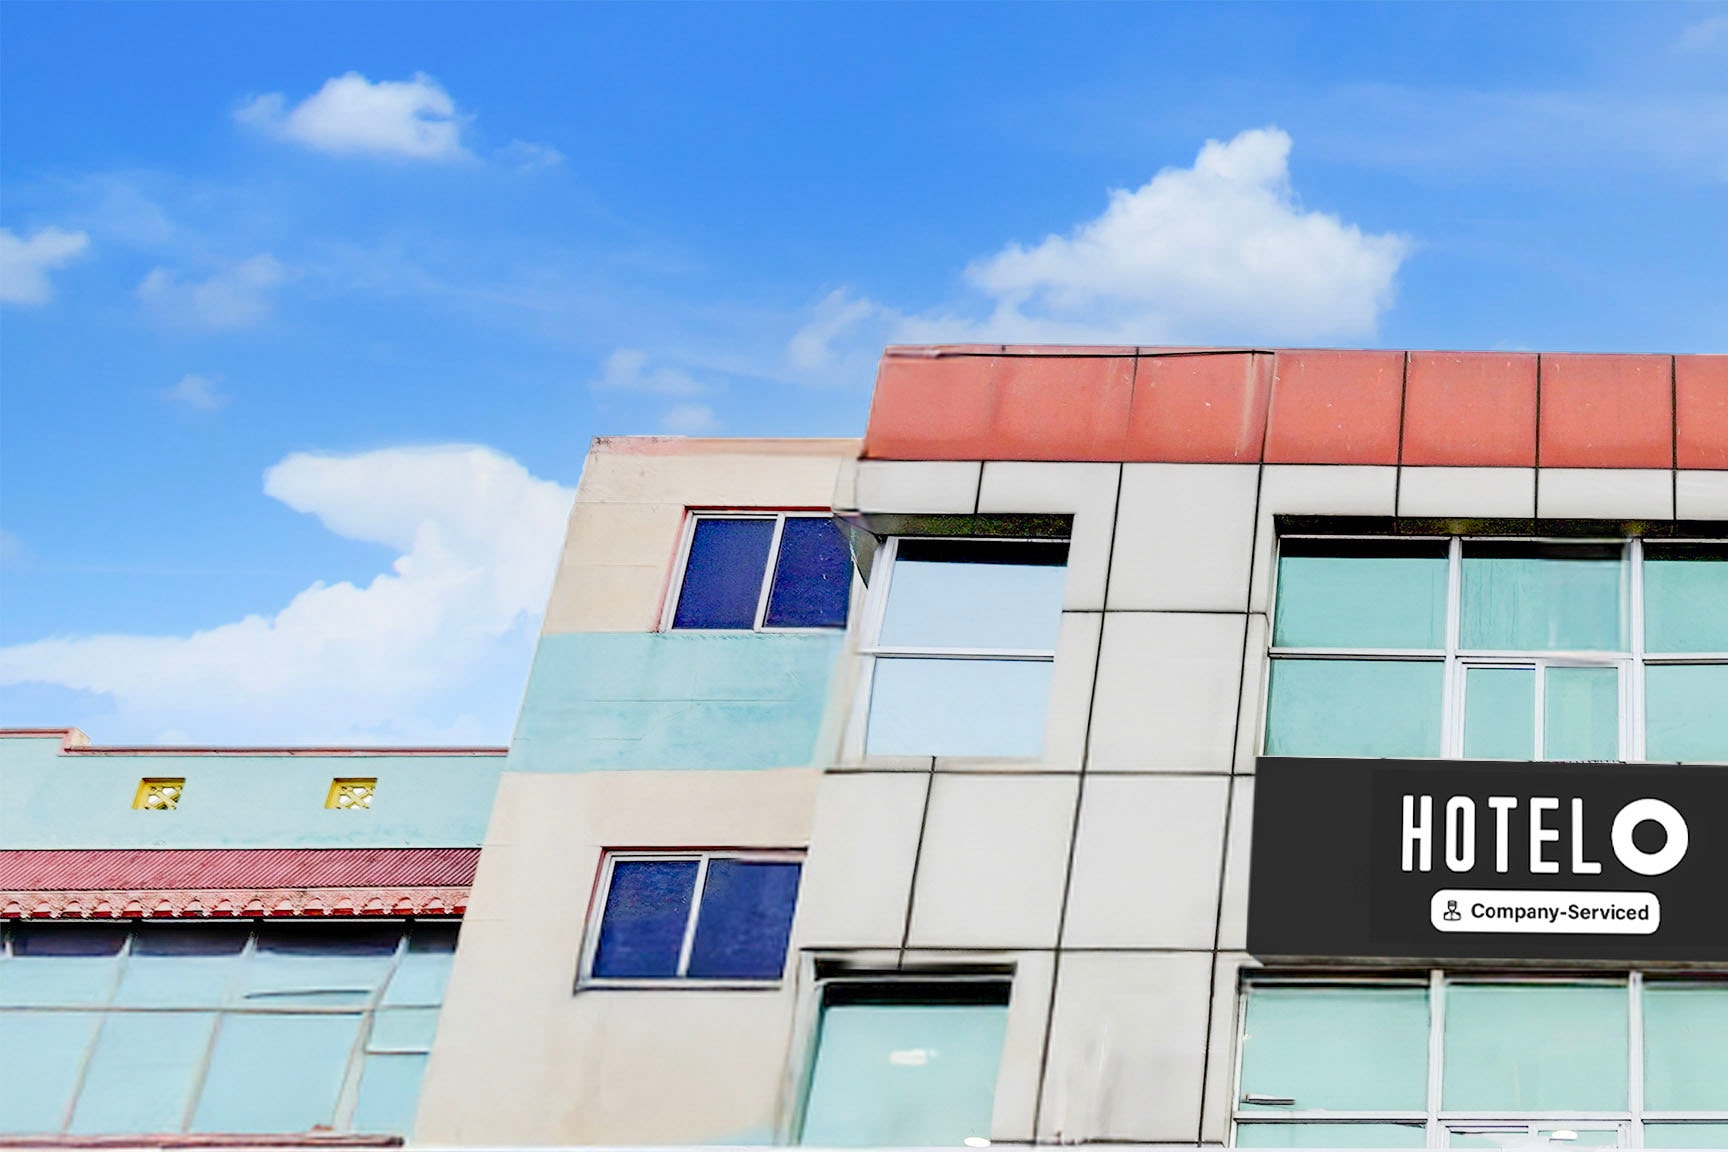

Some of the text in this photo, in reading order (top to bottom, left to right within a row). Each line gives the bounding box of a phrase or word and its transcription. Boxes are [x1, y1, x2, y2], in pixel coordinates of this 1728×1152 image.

[1402, 795, 1689, 876] HOTEL O
[1471, 902, 1649, 924] Company-Serviced
